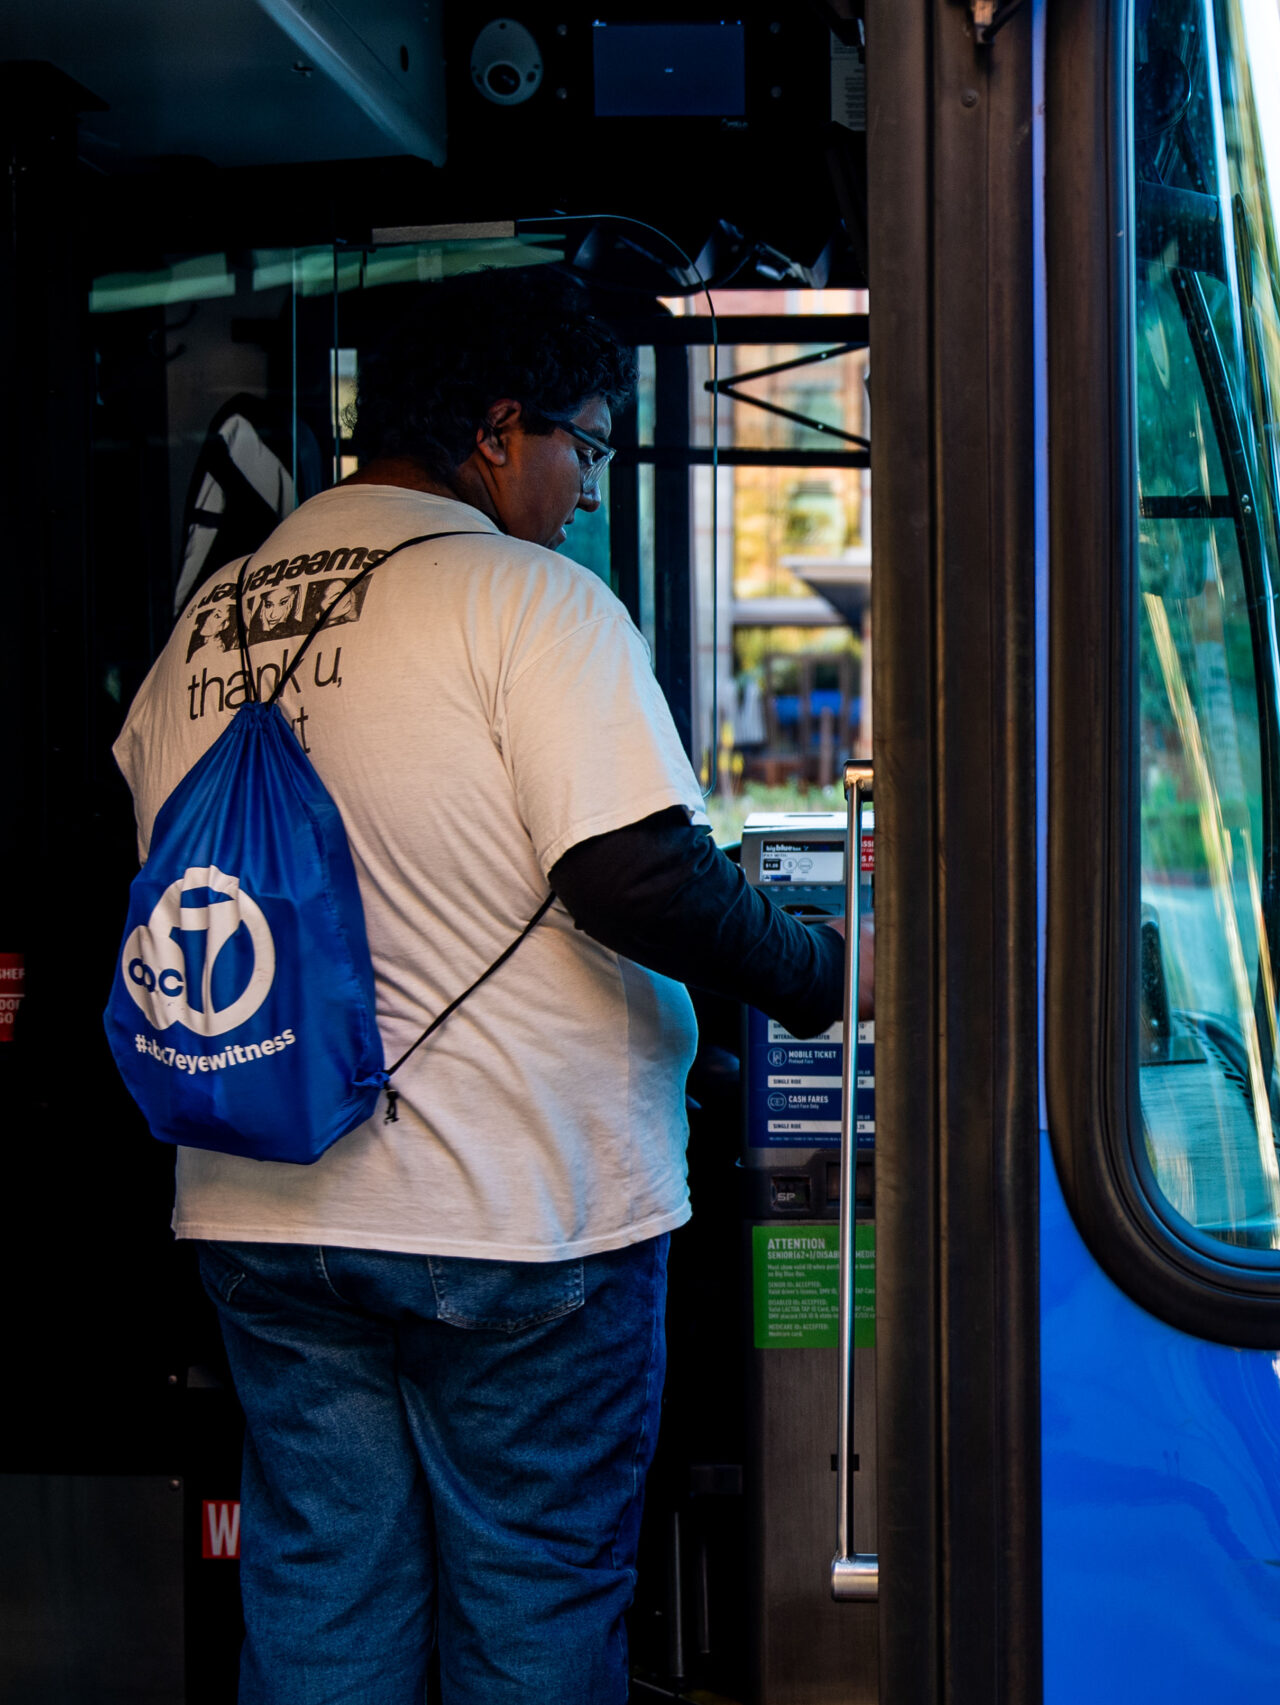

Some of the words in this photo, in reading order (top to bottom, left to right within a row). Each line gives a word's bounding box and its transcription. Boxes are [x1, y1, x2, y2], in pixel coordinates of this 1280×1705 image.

[187, 649, 304, 721] thank
[788, 1050, 813, 1059] MOBILE
[814, 1050, 837, 1059] TICKET
[788, 1095, 807, 1104] CASH
[808, 1095, 830, 1104] FARES
[767, 1238, 826, 1250] ATTENTION
